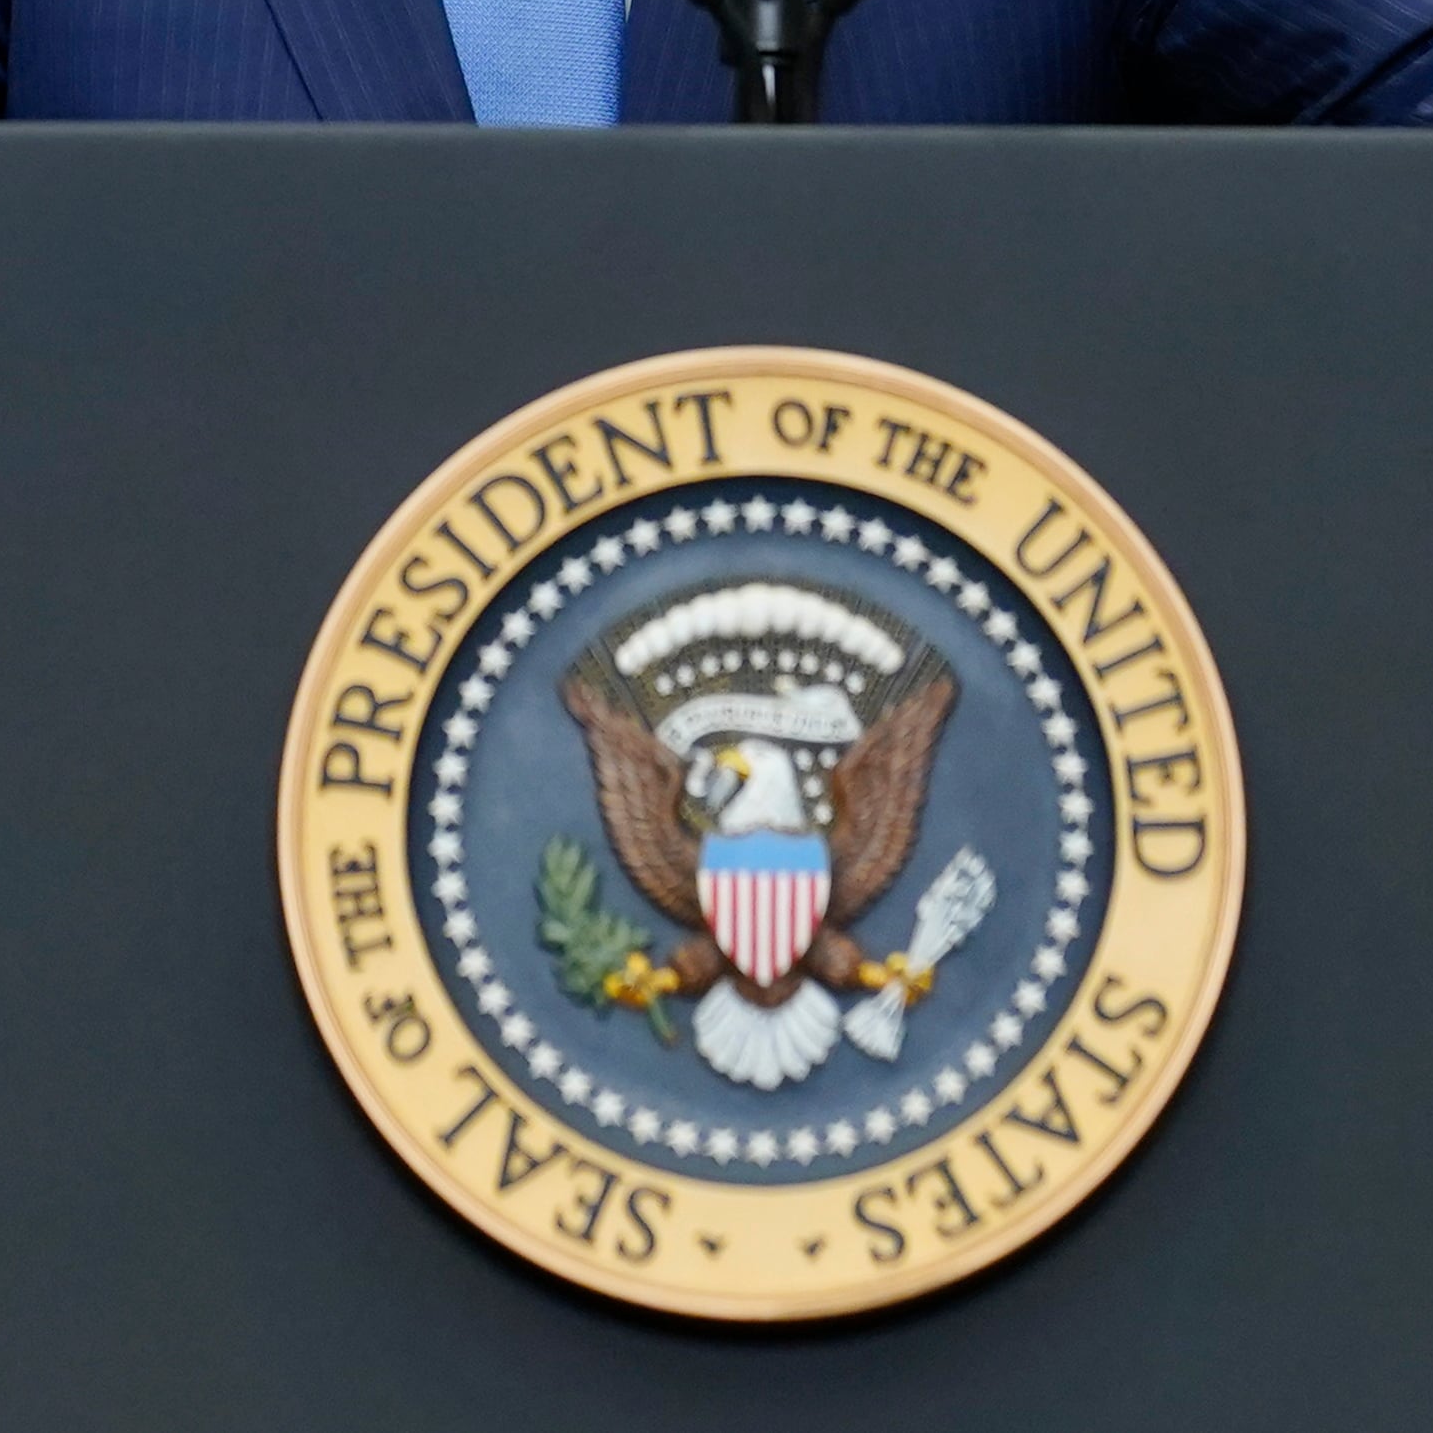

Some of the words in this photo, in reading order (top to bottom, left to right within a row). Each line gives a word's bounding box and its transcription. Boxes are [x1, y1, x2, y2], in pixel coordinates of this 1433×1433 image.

[772, 399, 852, 455] OF
[877, 418, 988, 506] THE
[320, 390, 733, 799] PRESIDENT
[1013, 494, 1207, 881] UNITED
[330, 839, 394, 966] THE
[363, 993, 434, 1063] OF
[436, 1064, 674, 1263] SEAL
[852, 974, 1167, 1265] STATES
